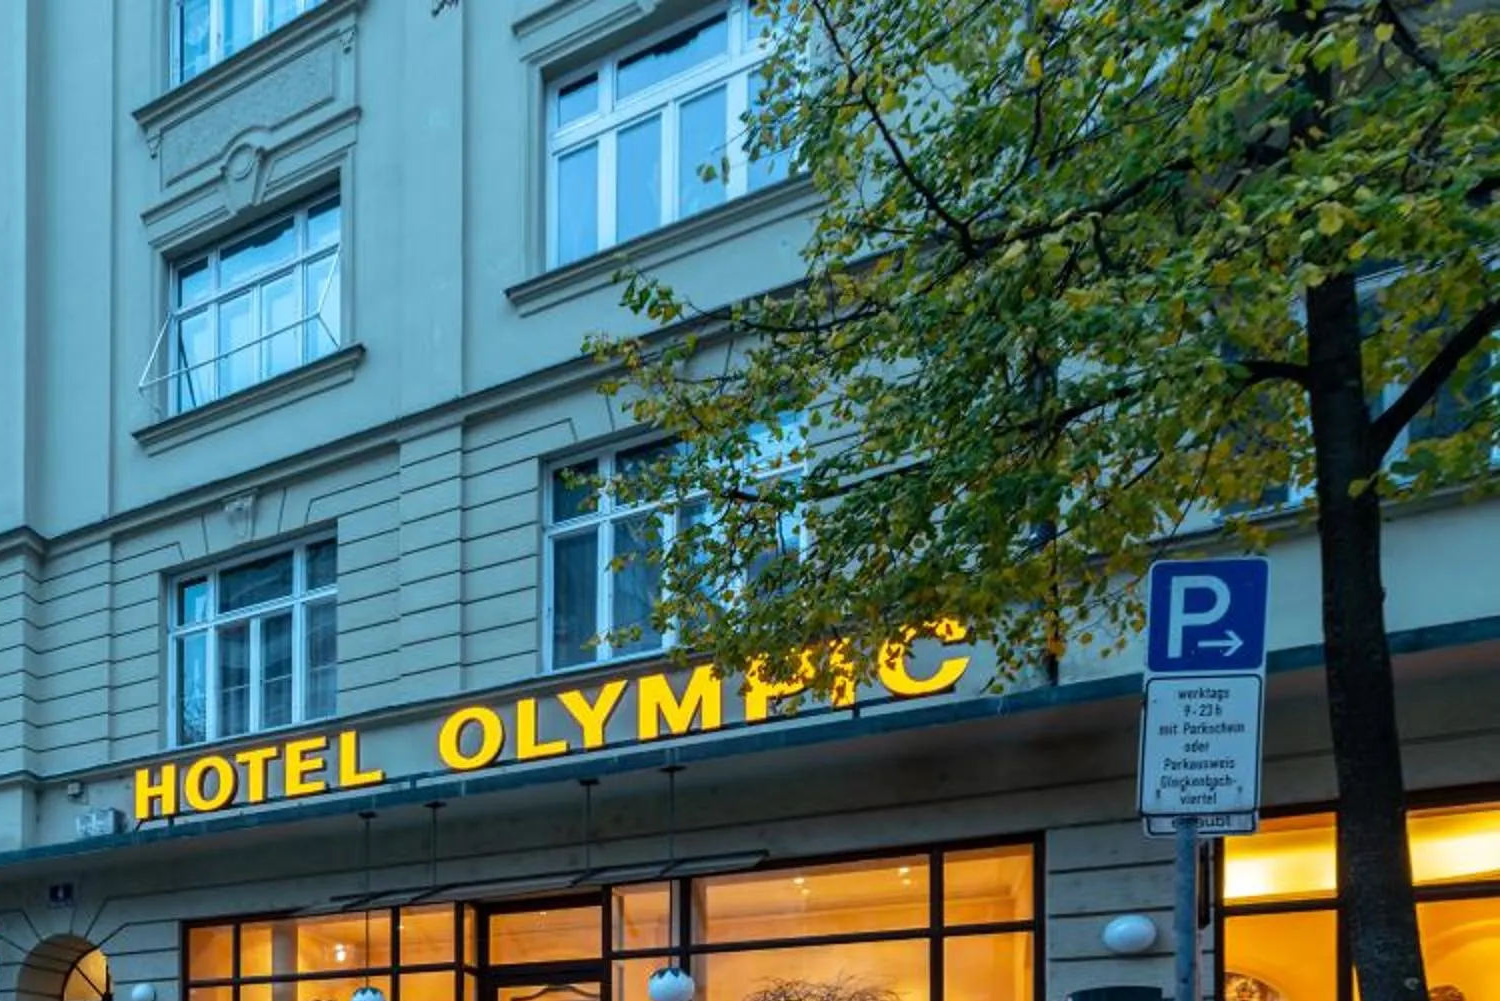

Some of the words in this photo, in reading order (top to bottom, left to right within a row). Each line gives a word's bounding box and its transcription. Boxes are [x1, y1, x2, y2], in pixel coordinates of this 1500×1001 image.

[1167, 575, 1231, 659] P
[1178, 687, 1229, 701] werktags
[1159, 722, 1178, 736] mit
[1183, 721, 1245, 735] Parkschein
[1183, 740, 1210, 753] oder
[1163, 757, 1236, 770] Parkausweis
[134, 731, 383, 820] HOTEL
